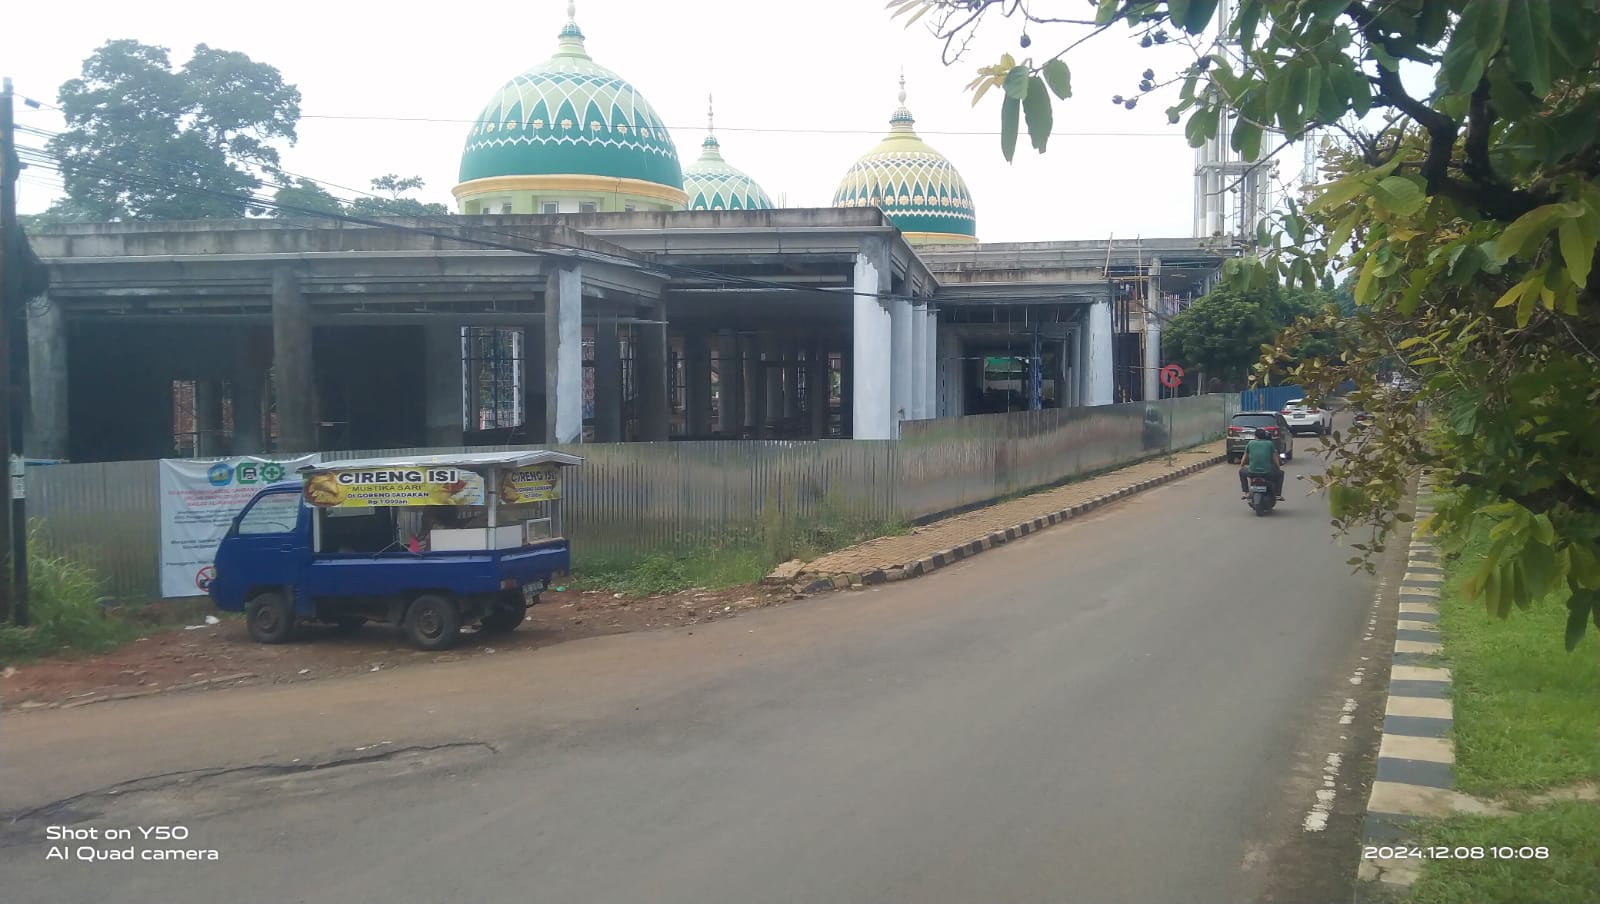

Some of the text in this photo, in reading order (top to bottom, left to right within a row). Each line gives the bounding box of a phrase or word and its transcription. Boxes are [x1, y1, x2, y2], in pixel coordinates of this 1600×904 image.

[338, 470, 456, 483] CIRENG ISI
[512, 471, 543, 482] CIRENG
